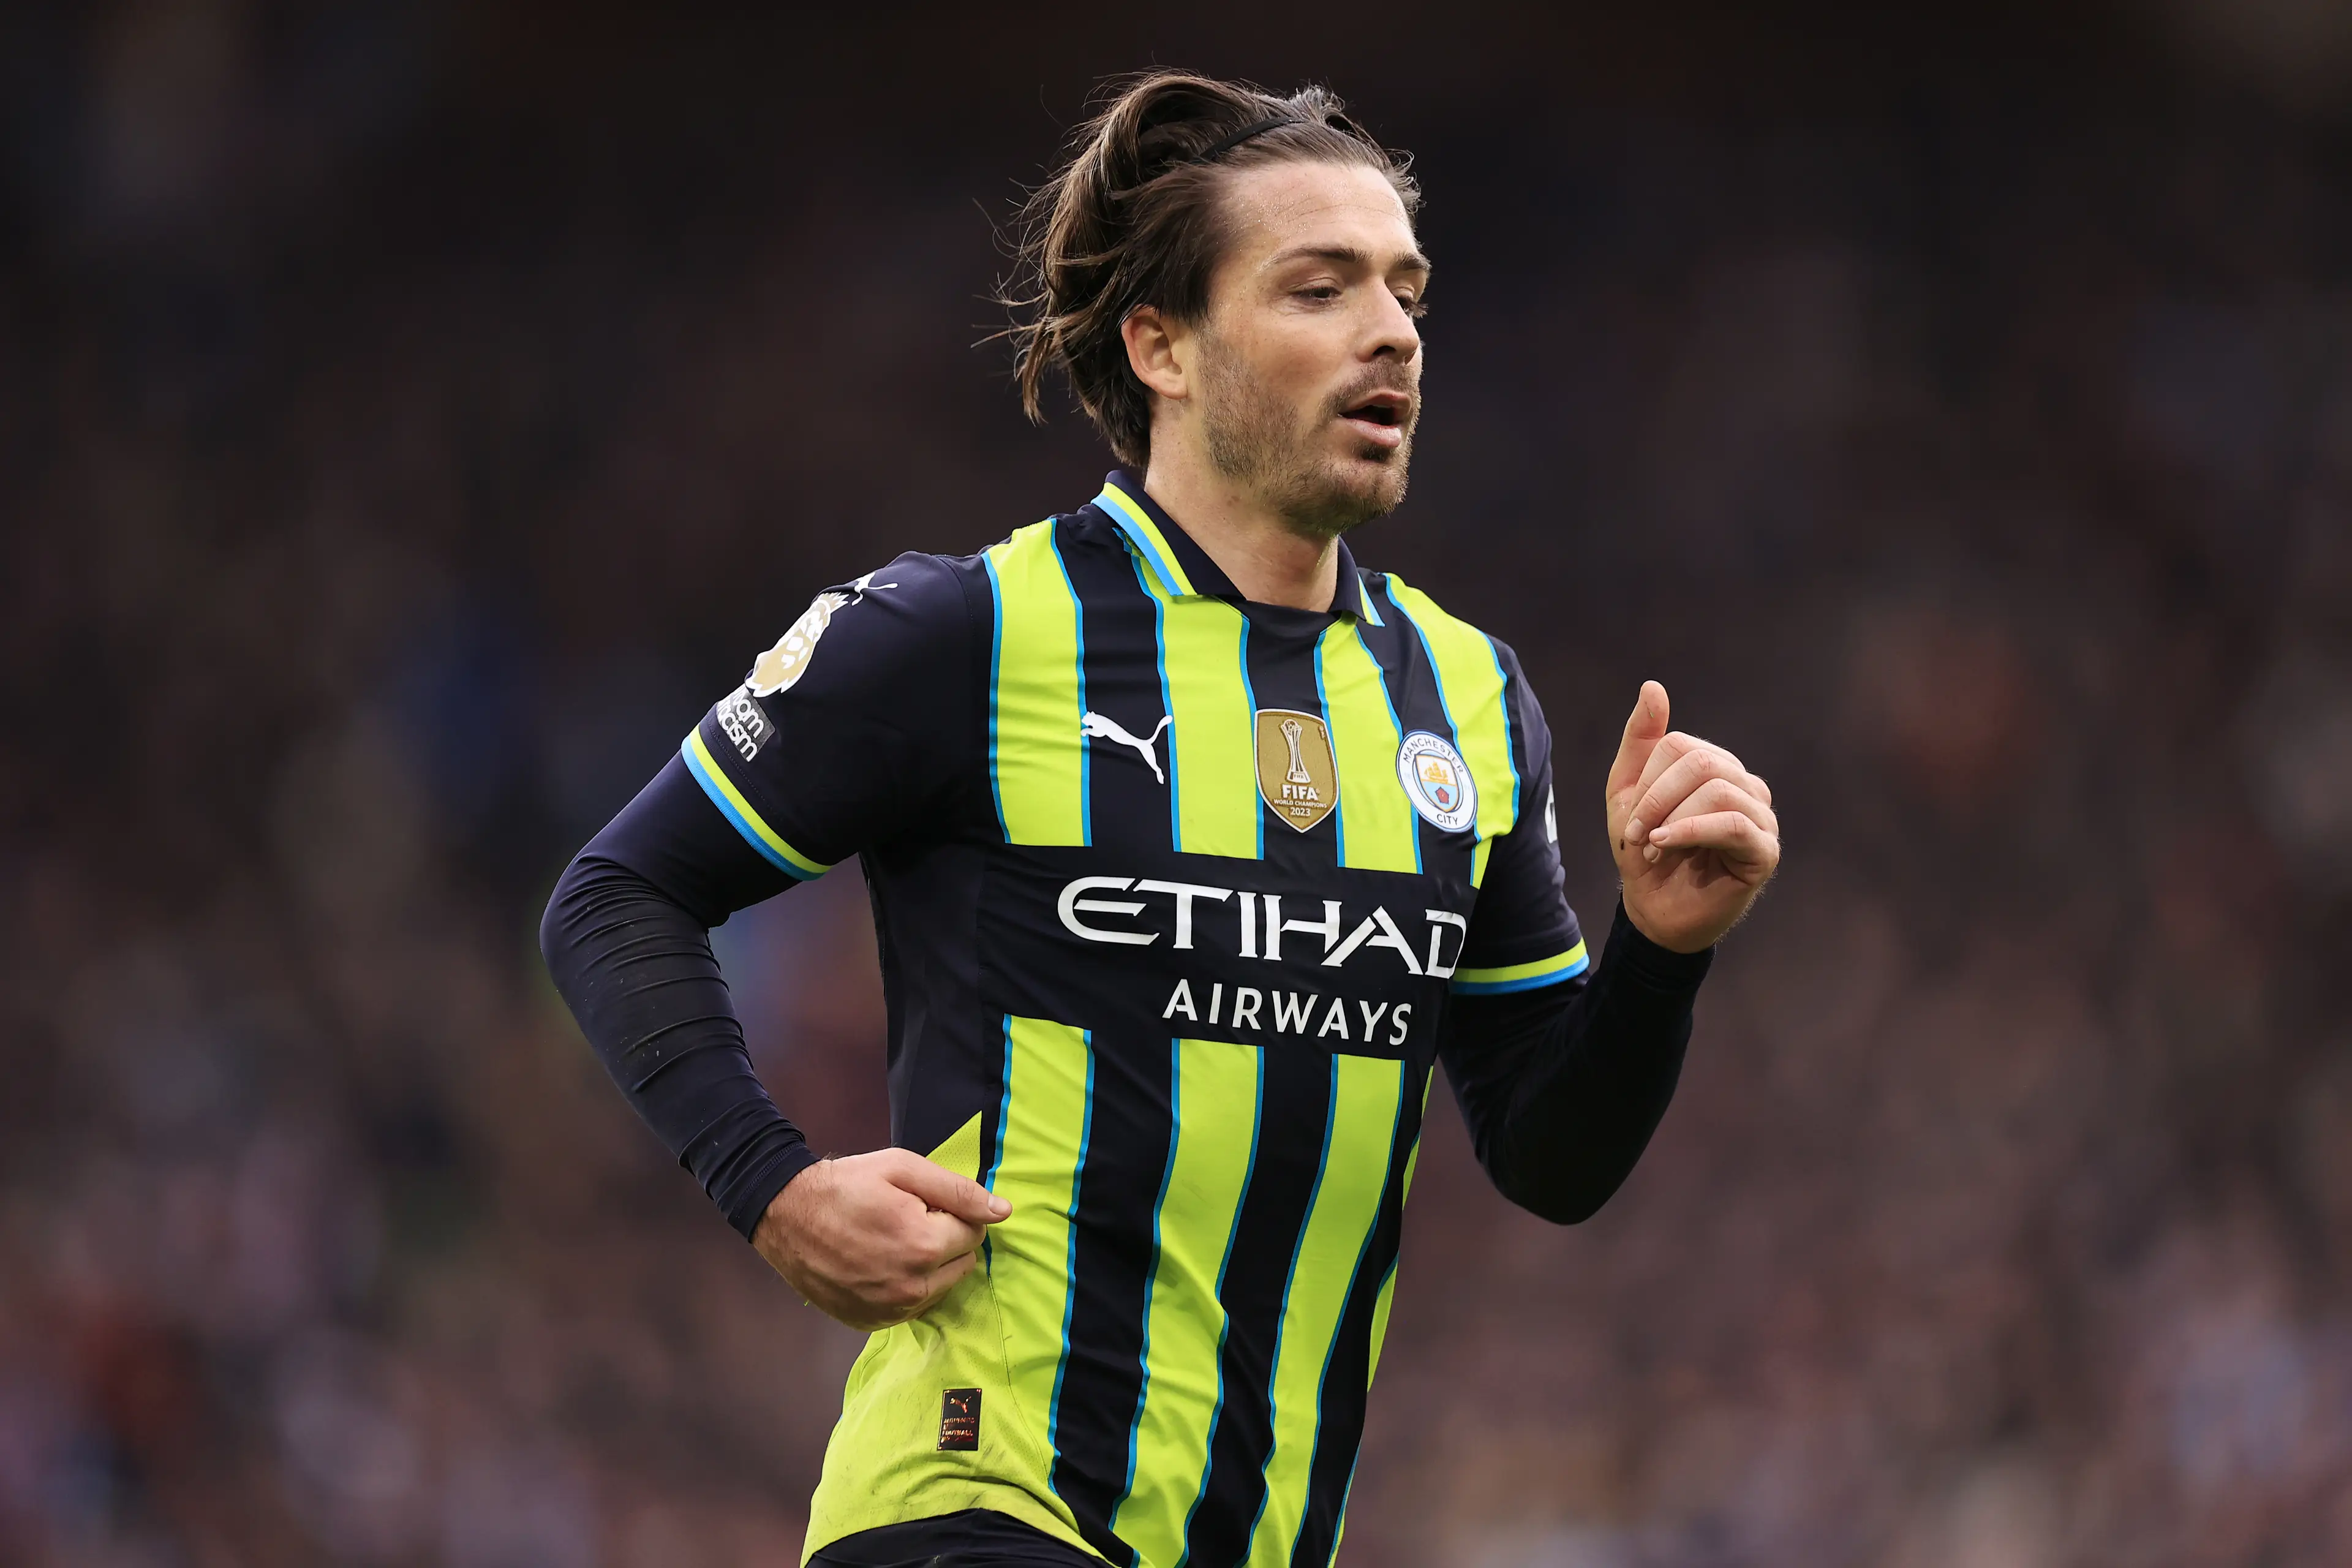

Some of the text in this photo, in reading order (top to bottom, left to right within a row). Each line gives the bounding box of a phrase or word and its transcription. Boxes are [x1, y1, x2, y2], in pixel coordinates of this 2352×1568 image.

[1403, 737, 1464, 773] MANCHESTER
[1290, 807, 1311, 816] 2023
[1436, 813, 1458, 825] CITY
[1058, 876, 1467, 979] ETIHAD
[1163, 979, 1412, 1046] AIRWAYS
